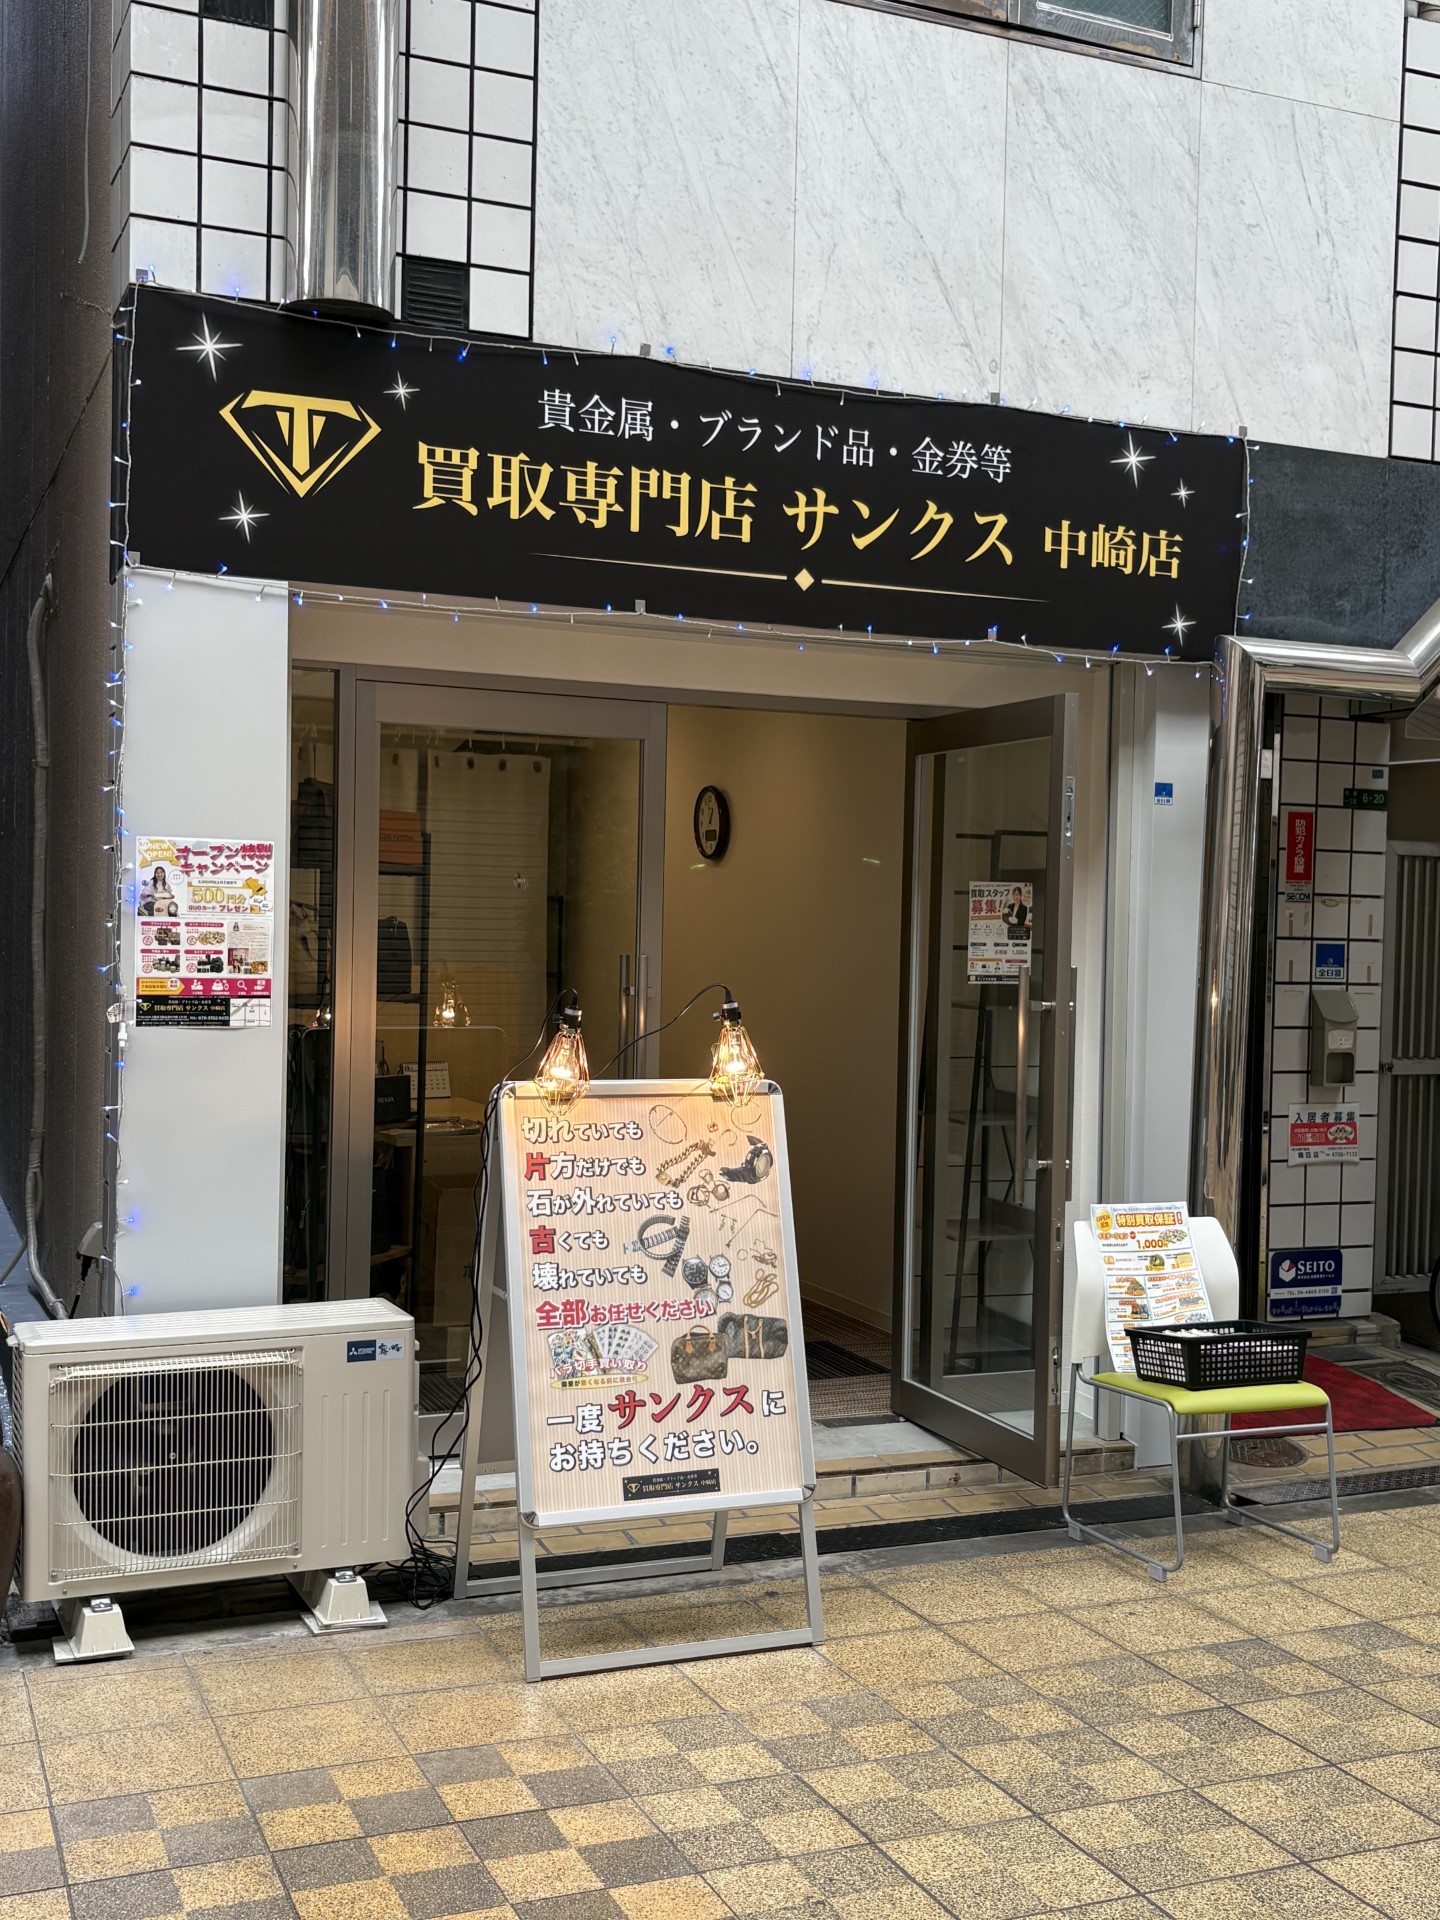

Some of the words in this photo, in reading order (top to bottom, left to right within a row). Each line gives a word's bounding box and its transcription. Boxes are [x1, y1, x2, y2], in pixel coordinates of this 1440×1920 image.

[537, 388, 1013, 483] 貴金属・ブランド品・金券等
[412, 441, 758, 544] 買取専門店
[782, 487, 1015, 566] サンクス
[1044, 519, 1184, 579] 中崎店
[1362, 792, 1385, 804] 6-20
[147, 850, 173, 858] OPEN!
[149, 842, 169, 850] NEW
[175, 843, 273, 861] オープン特別
[180, 861, 270, 877] キャンペーン
[192, 887, 247, 904] 500円分
[971, 888, 1010, 899] 買取スタッフ
[1286, 892, 1311, 900] SECOM
[1294, 1111, 1356, 1123] 入居者募集
[521, 1117, 643, 1143] 切れていても
[524, 1152, 646, 1181] 片方だけでも
[526, 1186, 684, 1217] 石が外れていても
[529, 1225, 610, 1255] 古くても
[532, 1262, 648, 1291] 壊れていても
[1297, 1260, 1335, 1274] SEITO
[535, 1298, 715, 1329] 全部お任せください
[549, 1357, 649, 1380] バラ切手買い取り
[549, 1429, 759, 1472] お持ちください。
